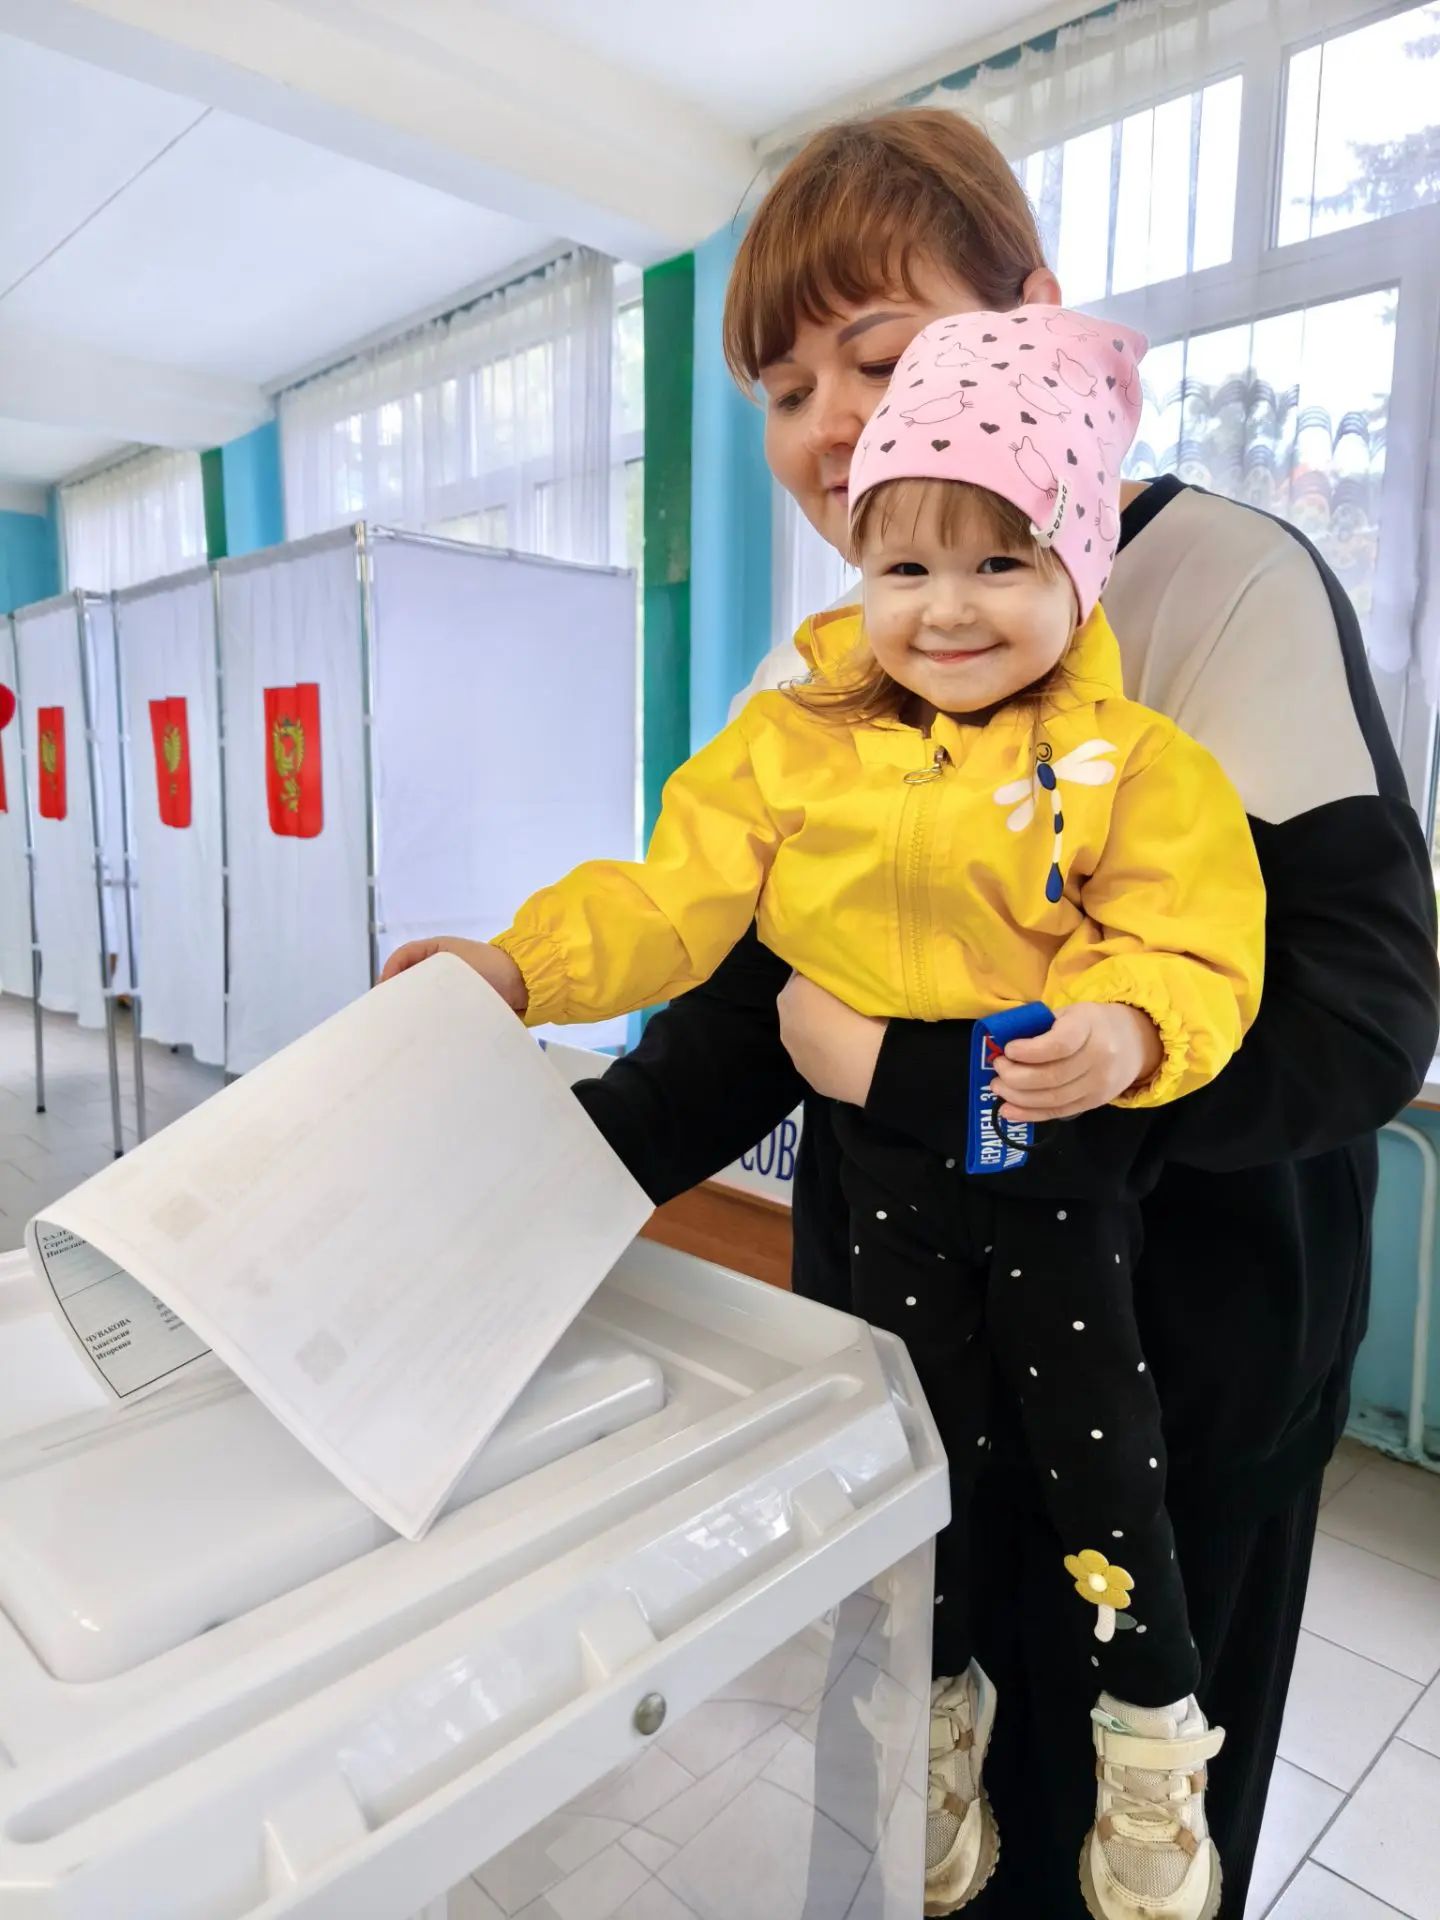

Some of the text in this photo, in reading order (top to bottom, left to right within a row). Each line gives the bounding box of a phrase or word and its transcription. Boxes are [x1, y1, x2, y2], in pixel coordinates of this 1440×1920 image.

[85, 1318, 132, 1343] ЧУВАКОВА
[90, 1329, 131, 1352] Анастасия
[95, 1340, 132, 1361] Игоревна
